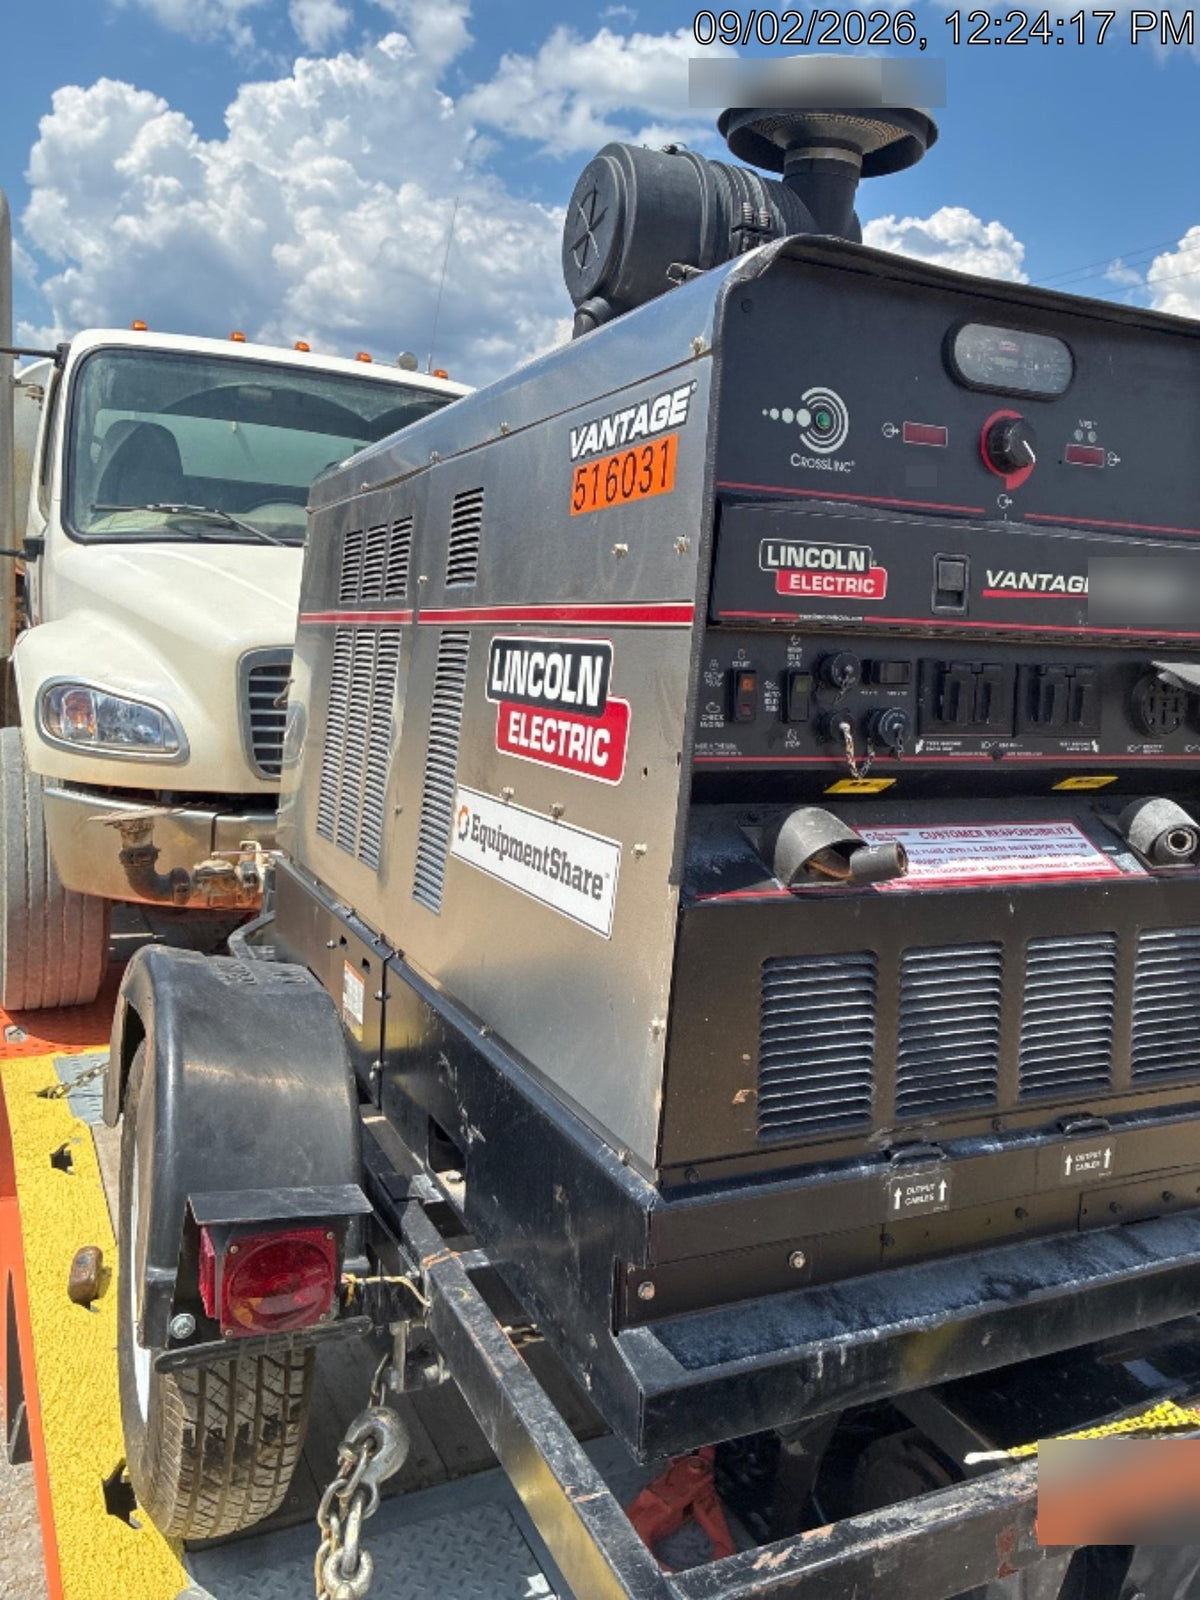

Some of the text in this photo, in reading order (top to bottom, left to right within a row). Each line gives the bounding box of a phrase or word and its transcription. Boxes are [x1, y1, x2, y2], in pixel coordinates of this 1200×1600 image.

[573, 440, 669, 511] 516031
[767, 545, 865, 572] LINCOLN
[789, 573, 876, 594] ELECTRIC
[986, 569, 1089, 594] VANTAG
[491, 648, 604, 707] LINCOLN
[507, 710, 611, 768] ELECTRIC
[918, 830, 983, 840] CUSTOMER
[985, 826, 1073, 838] RESPONSIBILITY
[470, 812, 604, 901] EquipmentShare
[906, 1183, 936, 1195] OUTPUT
